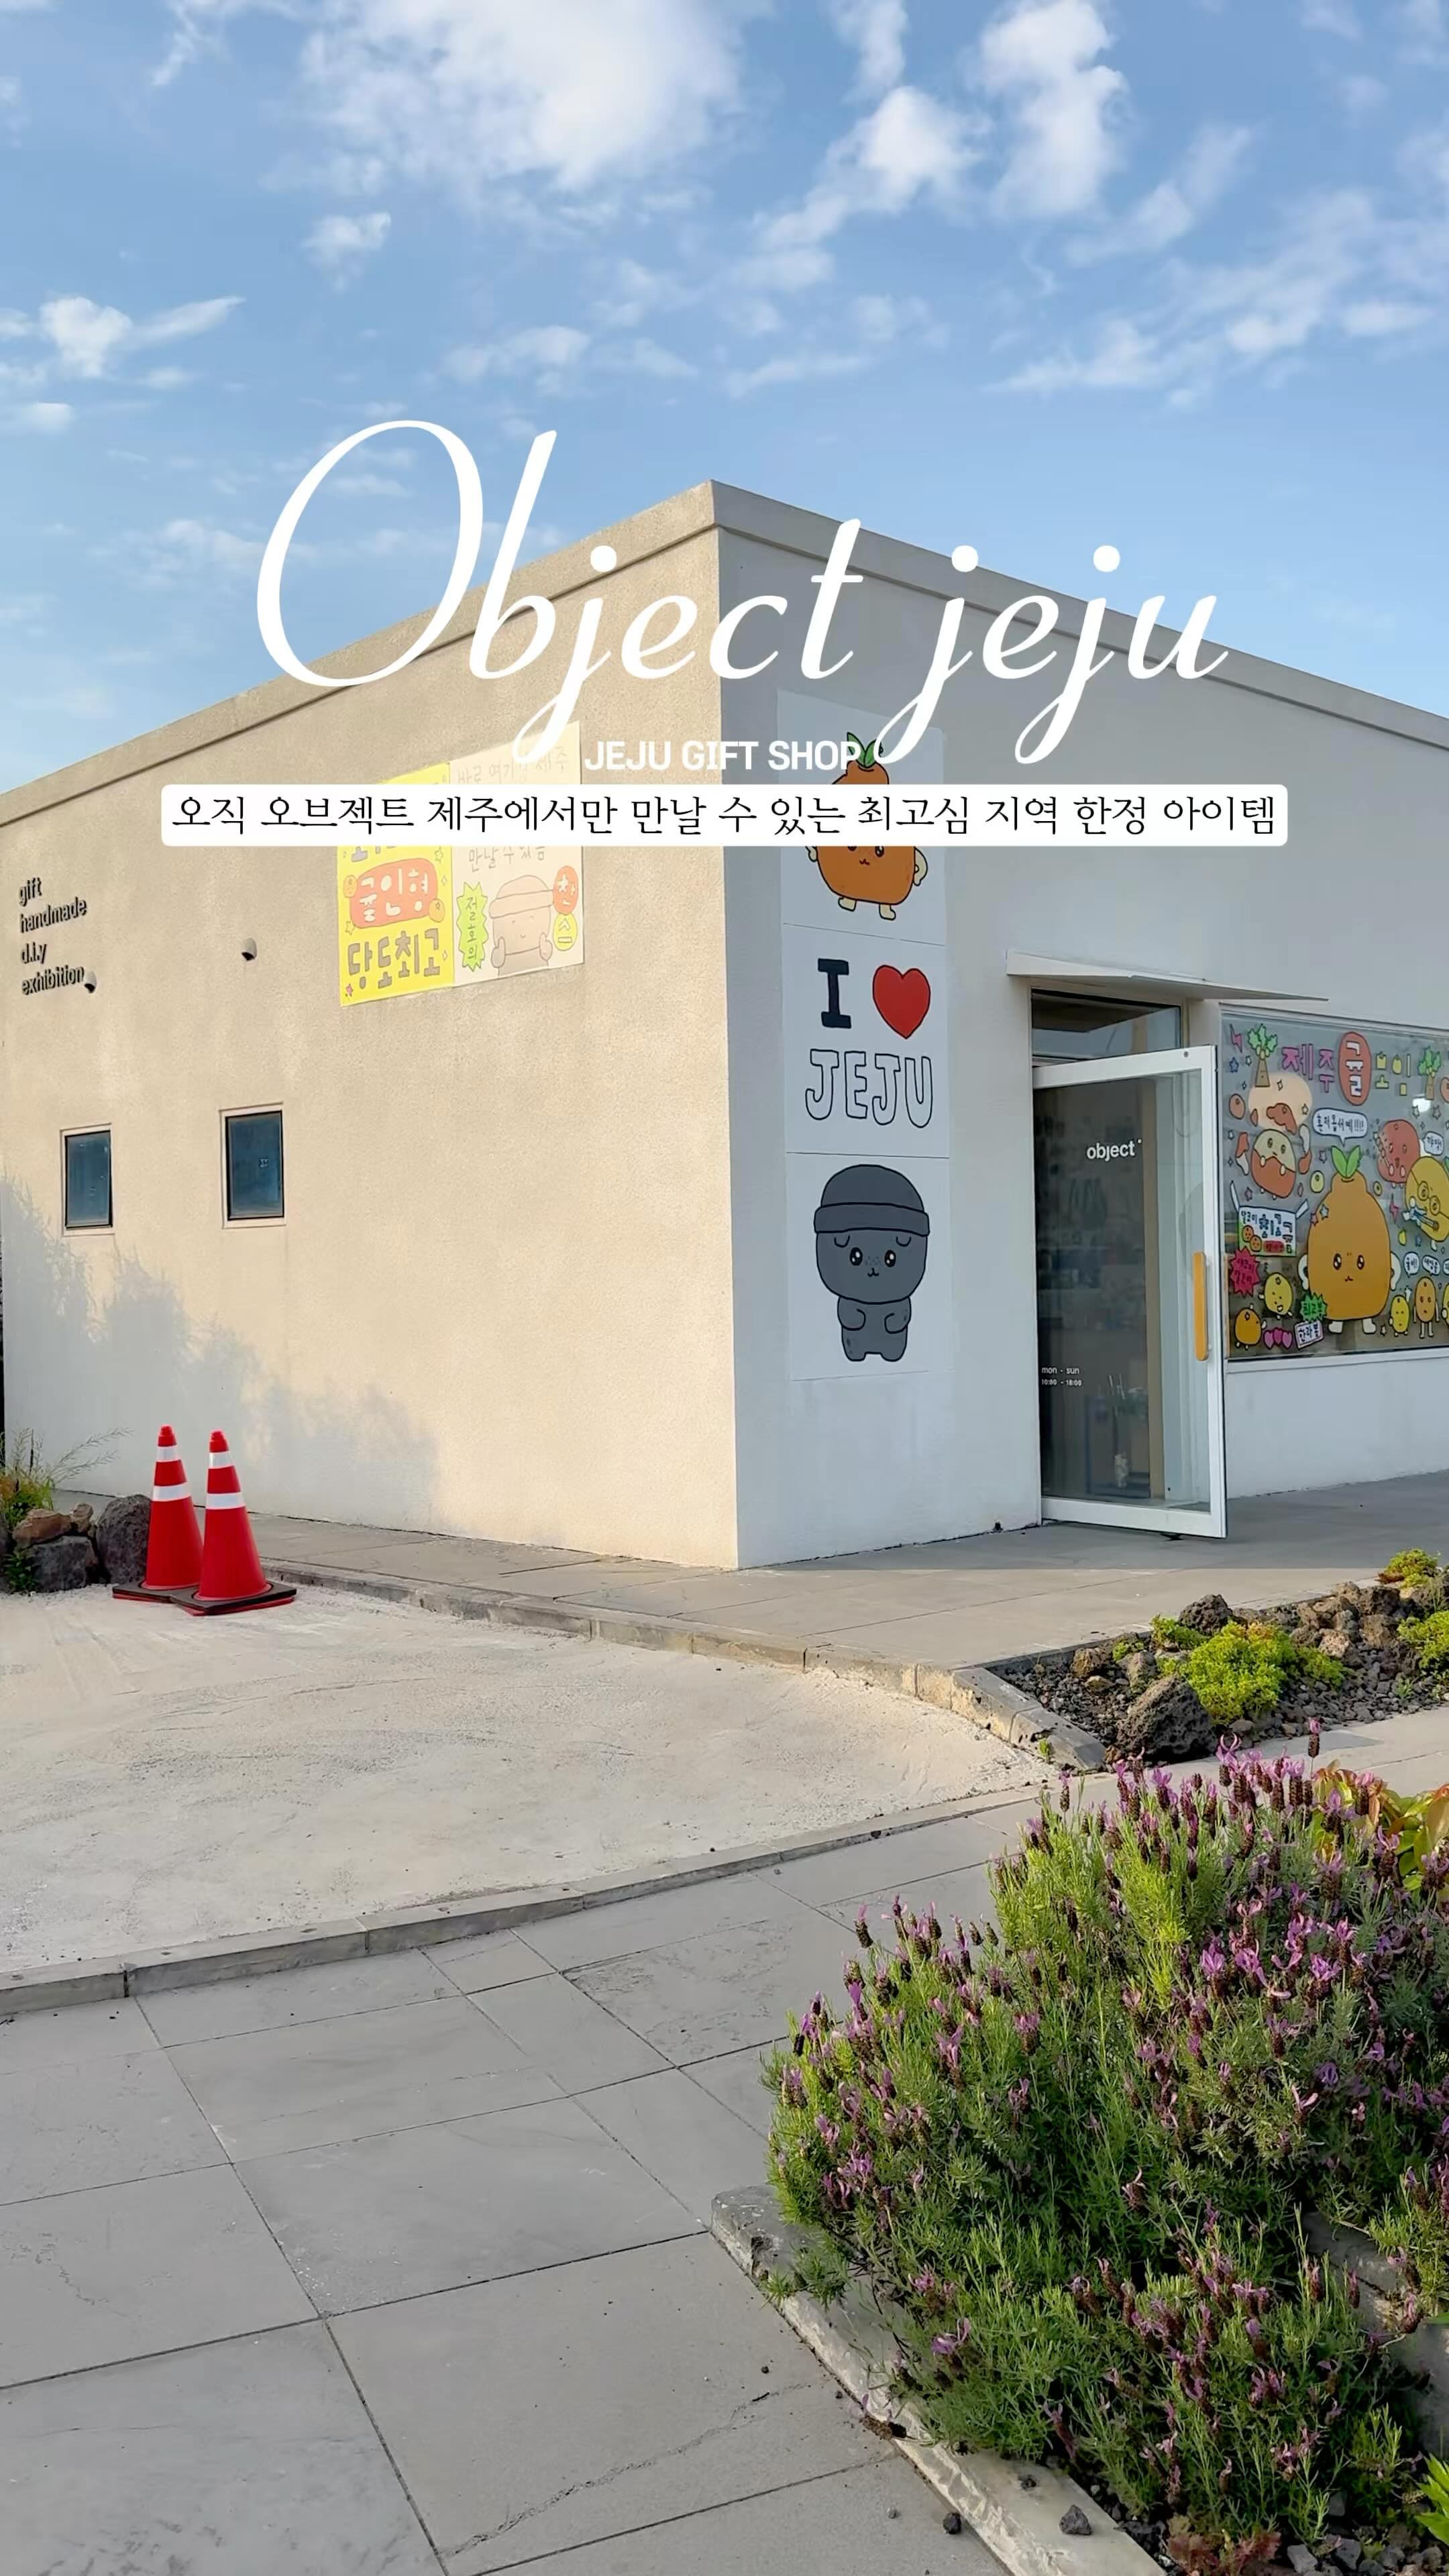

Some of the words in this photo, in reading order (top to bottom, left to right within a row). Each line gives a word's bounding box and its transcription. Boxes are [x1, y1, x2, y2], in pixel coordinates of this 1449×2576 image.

[19, 877, 42, 906] gift
[359, 867, 429, 923] 귤인형
[20, 896, 87, 933] handmade
[21, 942, 48, 964] d.i.y
[347, 928, 441, 990] 당도최고
[21, 964, 85, 995] exhibition
[817, 958, 851, 1029] I
[805, 1048, 933, 1128] JEJU
[1087, 1140, 1135, 1162] object
